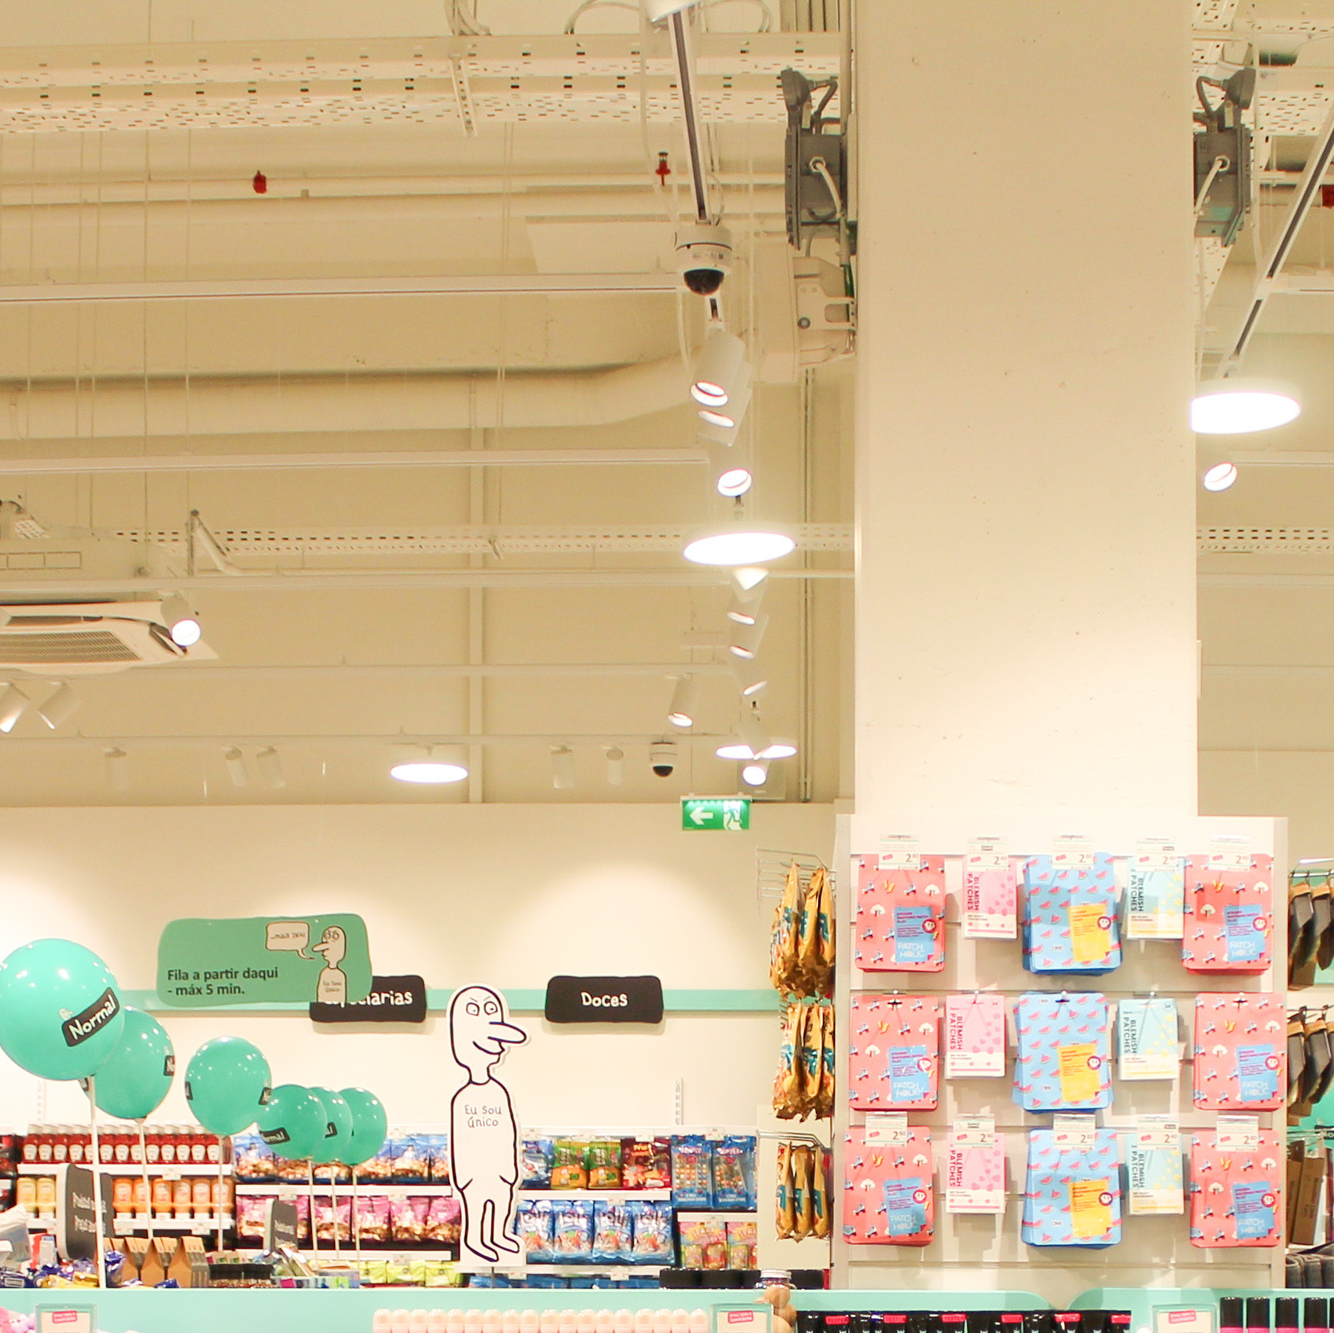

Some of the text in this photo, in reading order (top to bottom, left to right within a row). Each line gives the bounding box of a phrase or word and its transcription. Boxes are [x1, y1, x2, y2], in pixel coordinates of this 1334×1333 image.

[167, 967, 279, 984] Fila a partir daqui
[175, 983, 245, 996] máx 5 min.
[580, 991, 629, 1008] Doces
[67, 995, 117, 1040] Normal
[464, 1104, 502, 1116] Eu sou
[467, 1116, 499, 1128] único
